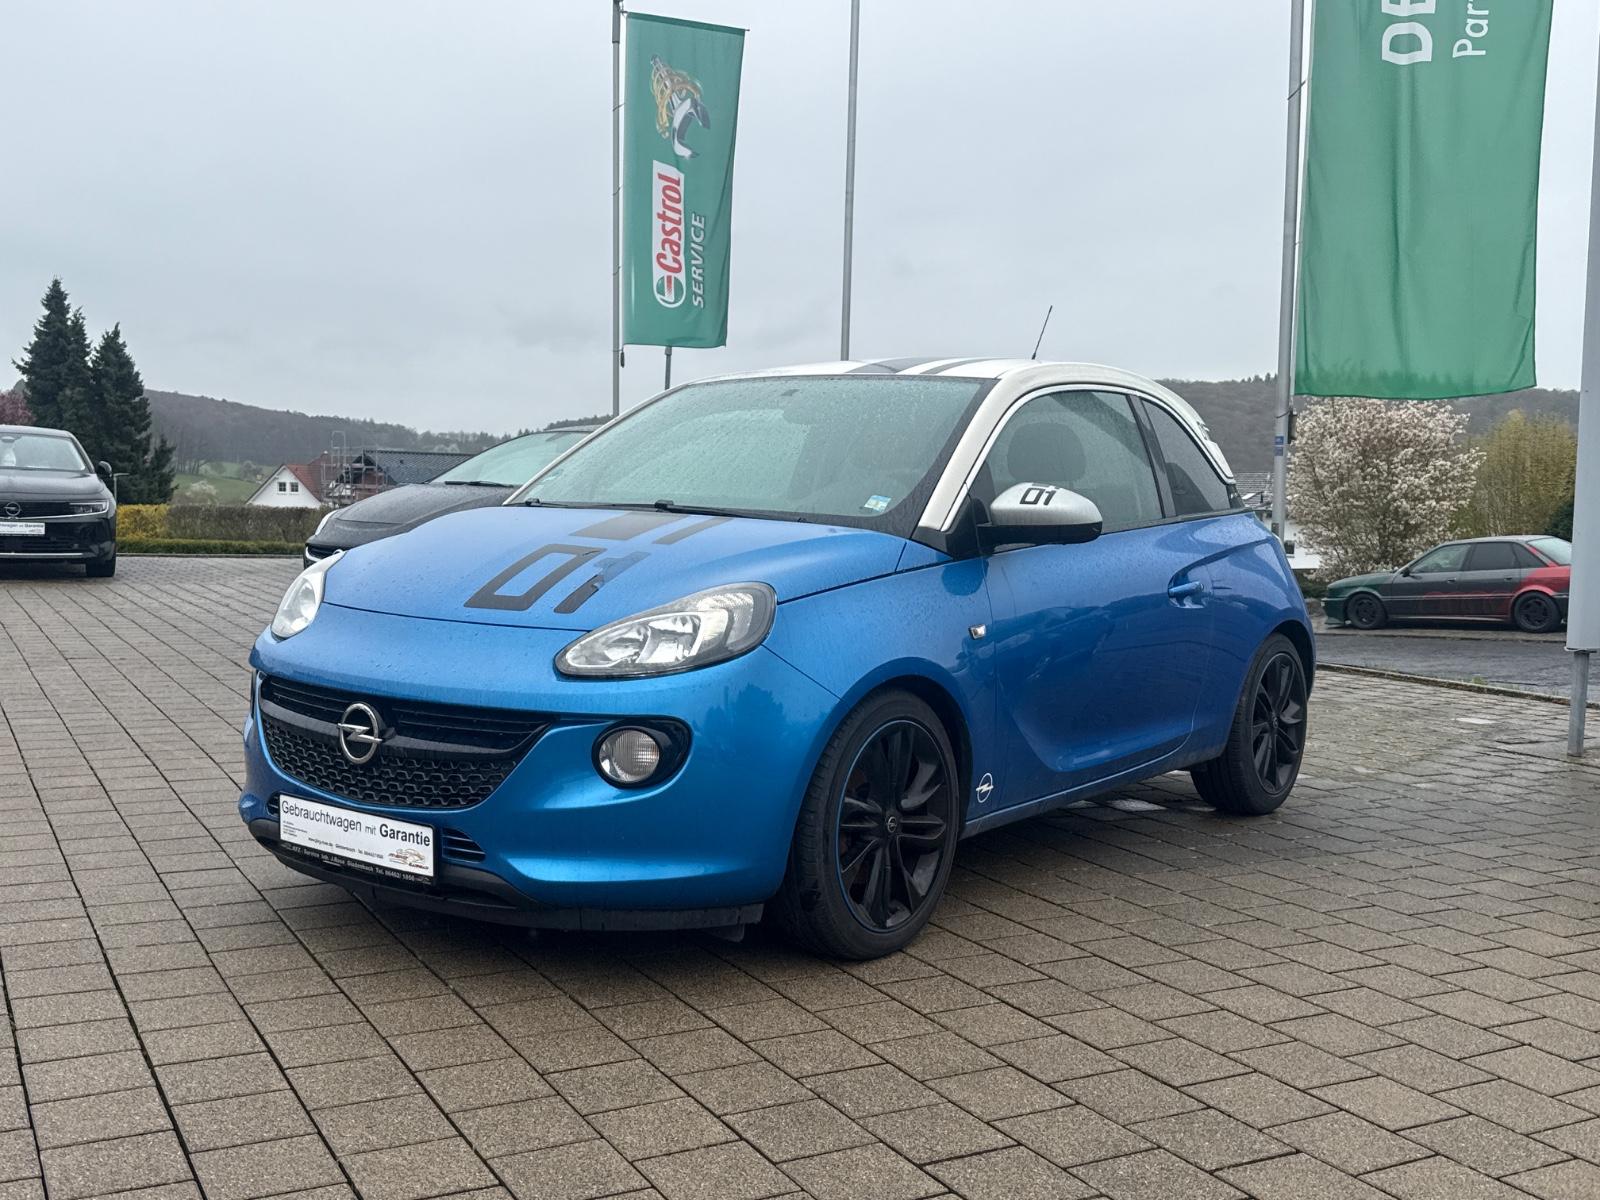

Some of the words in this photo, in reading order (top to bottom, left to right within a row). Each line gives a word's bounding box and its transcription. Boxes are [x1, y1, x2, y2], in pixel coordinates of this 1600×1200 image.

[1452, 0, 1489, 58] Par
[656, 172, 682, 274] Castrol
[691, 213, 706, 308] SERVICE
[281, 800, 362, 832] Gebrauchtwagen
[364, 825, 376, 836] mit
[379, 823, 431, 847] Garantie
